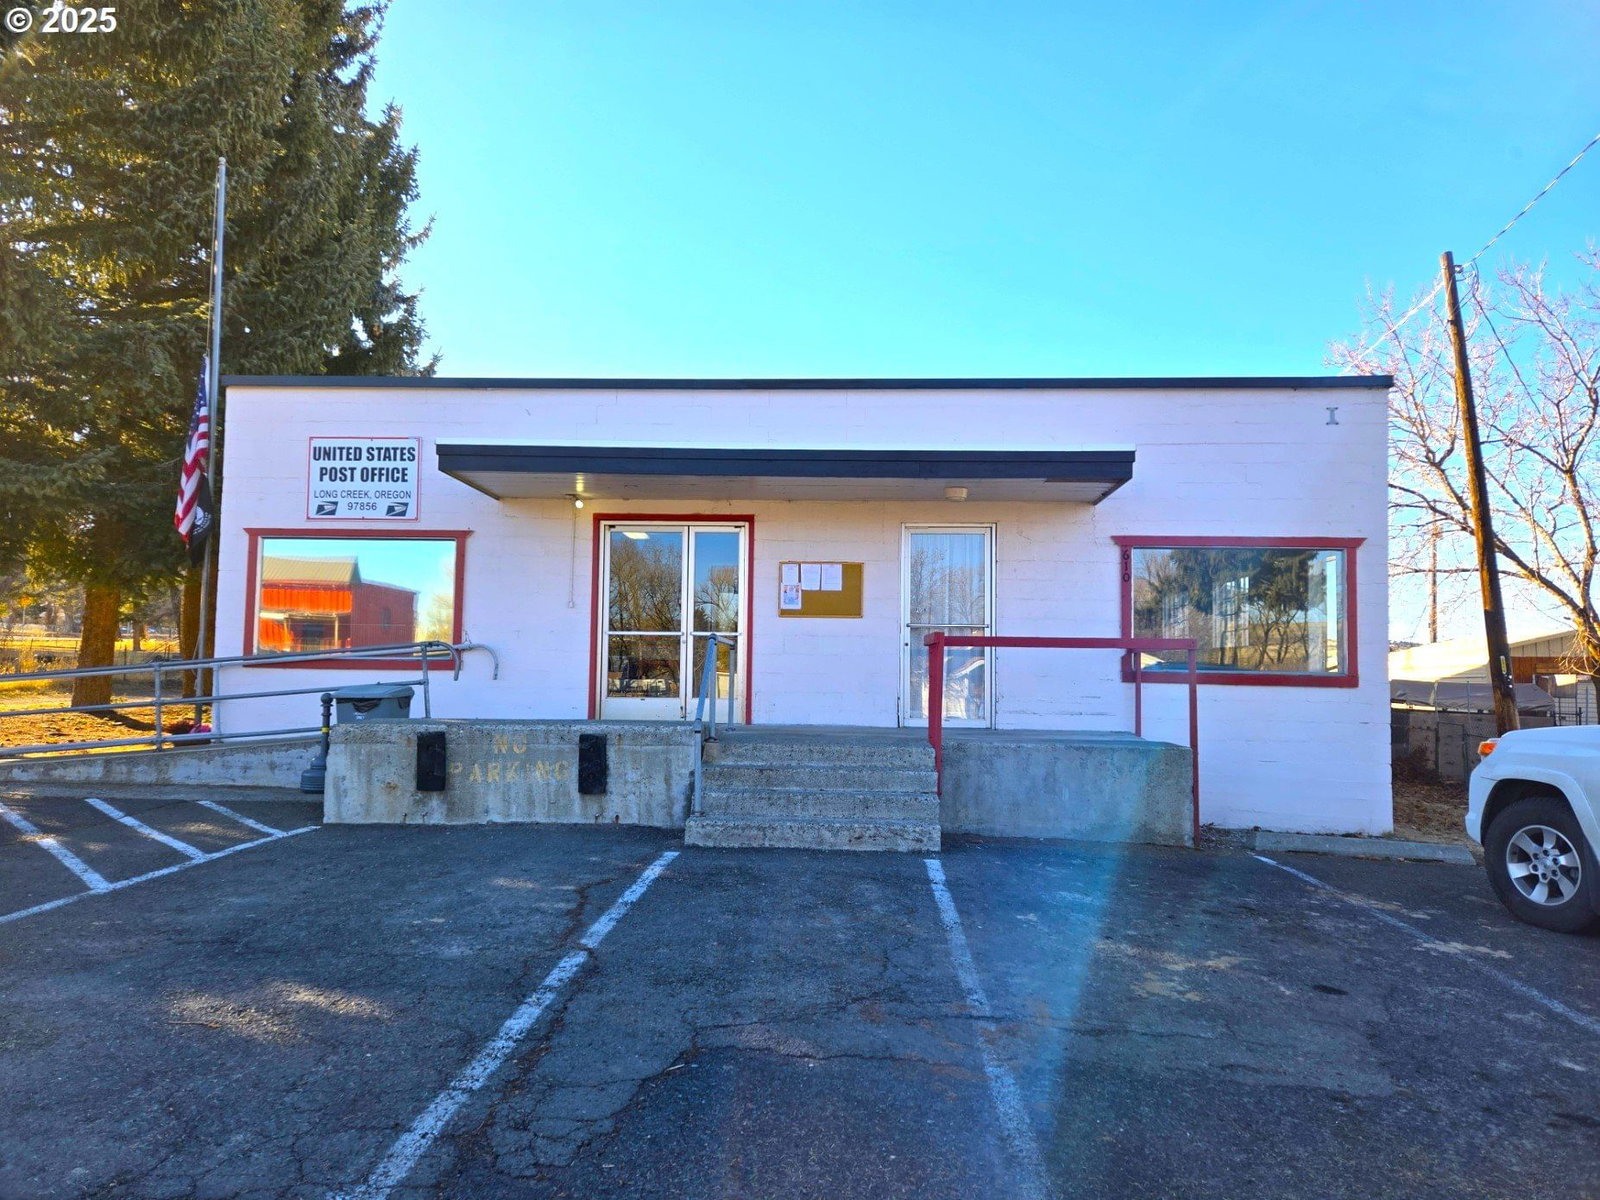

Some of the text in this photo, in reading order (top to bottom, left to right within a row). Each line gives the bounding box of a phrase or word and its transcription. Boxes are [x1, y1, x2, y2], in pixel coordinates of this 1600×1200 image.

[313, 446, 416, 462] UNITED STATES
[320, 467, 408, 482] POST OFFICE
[313, 490, 412, 500] LONG CREEK, OREGON
[347, 502, 378, 511] 97856
[493, 734, 527, 754] NO
[449, 761, 570, 783] PARKING
